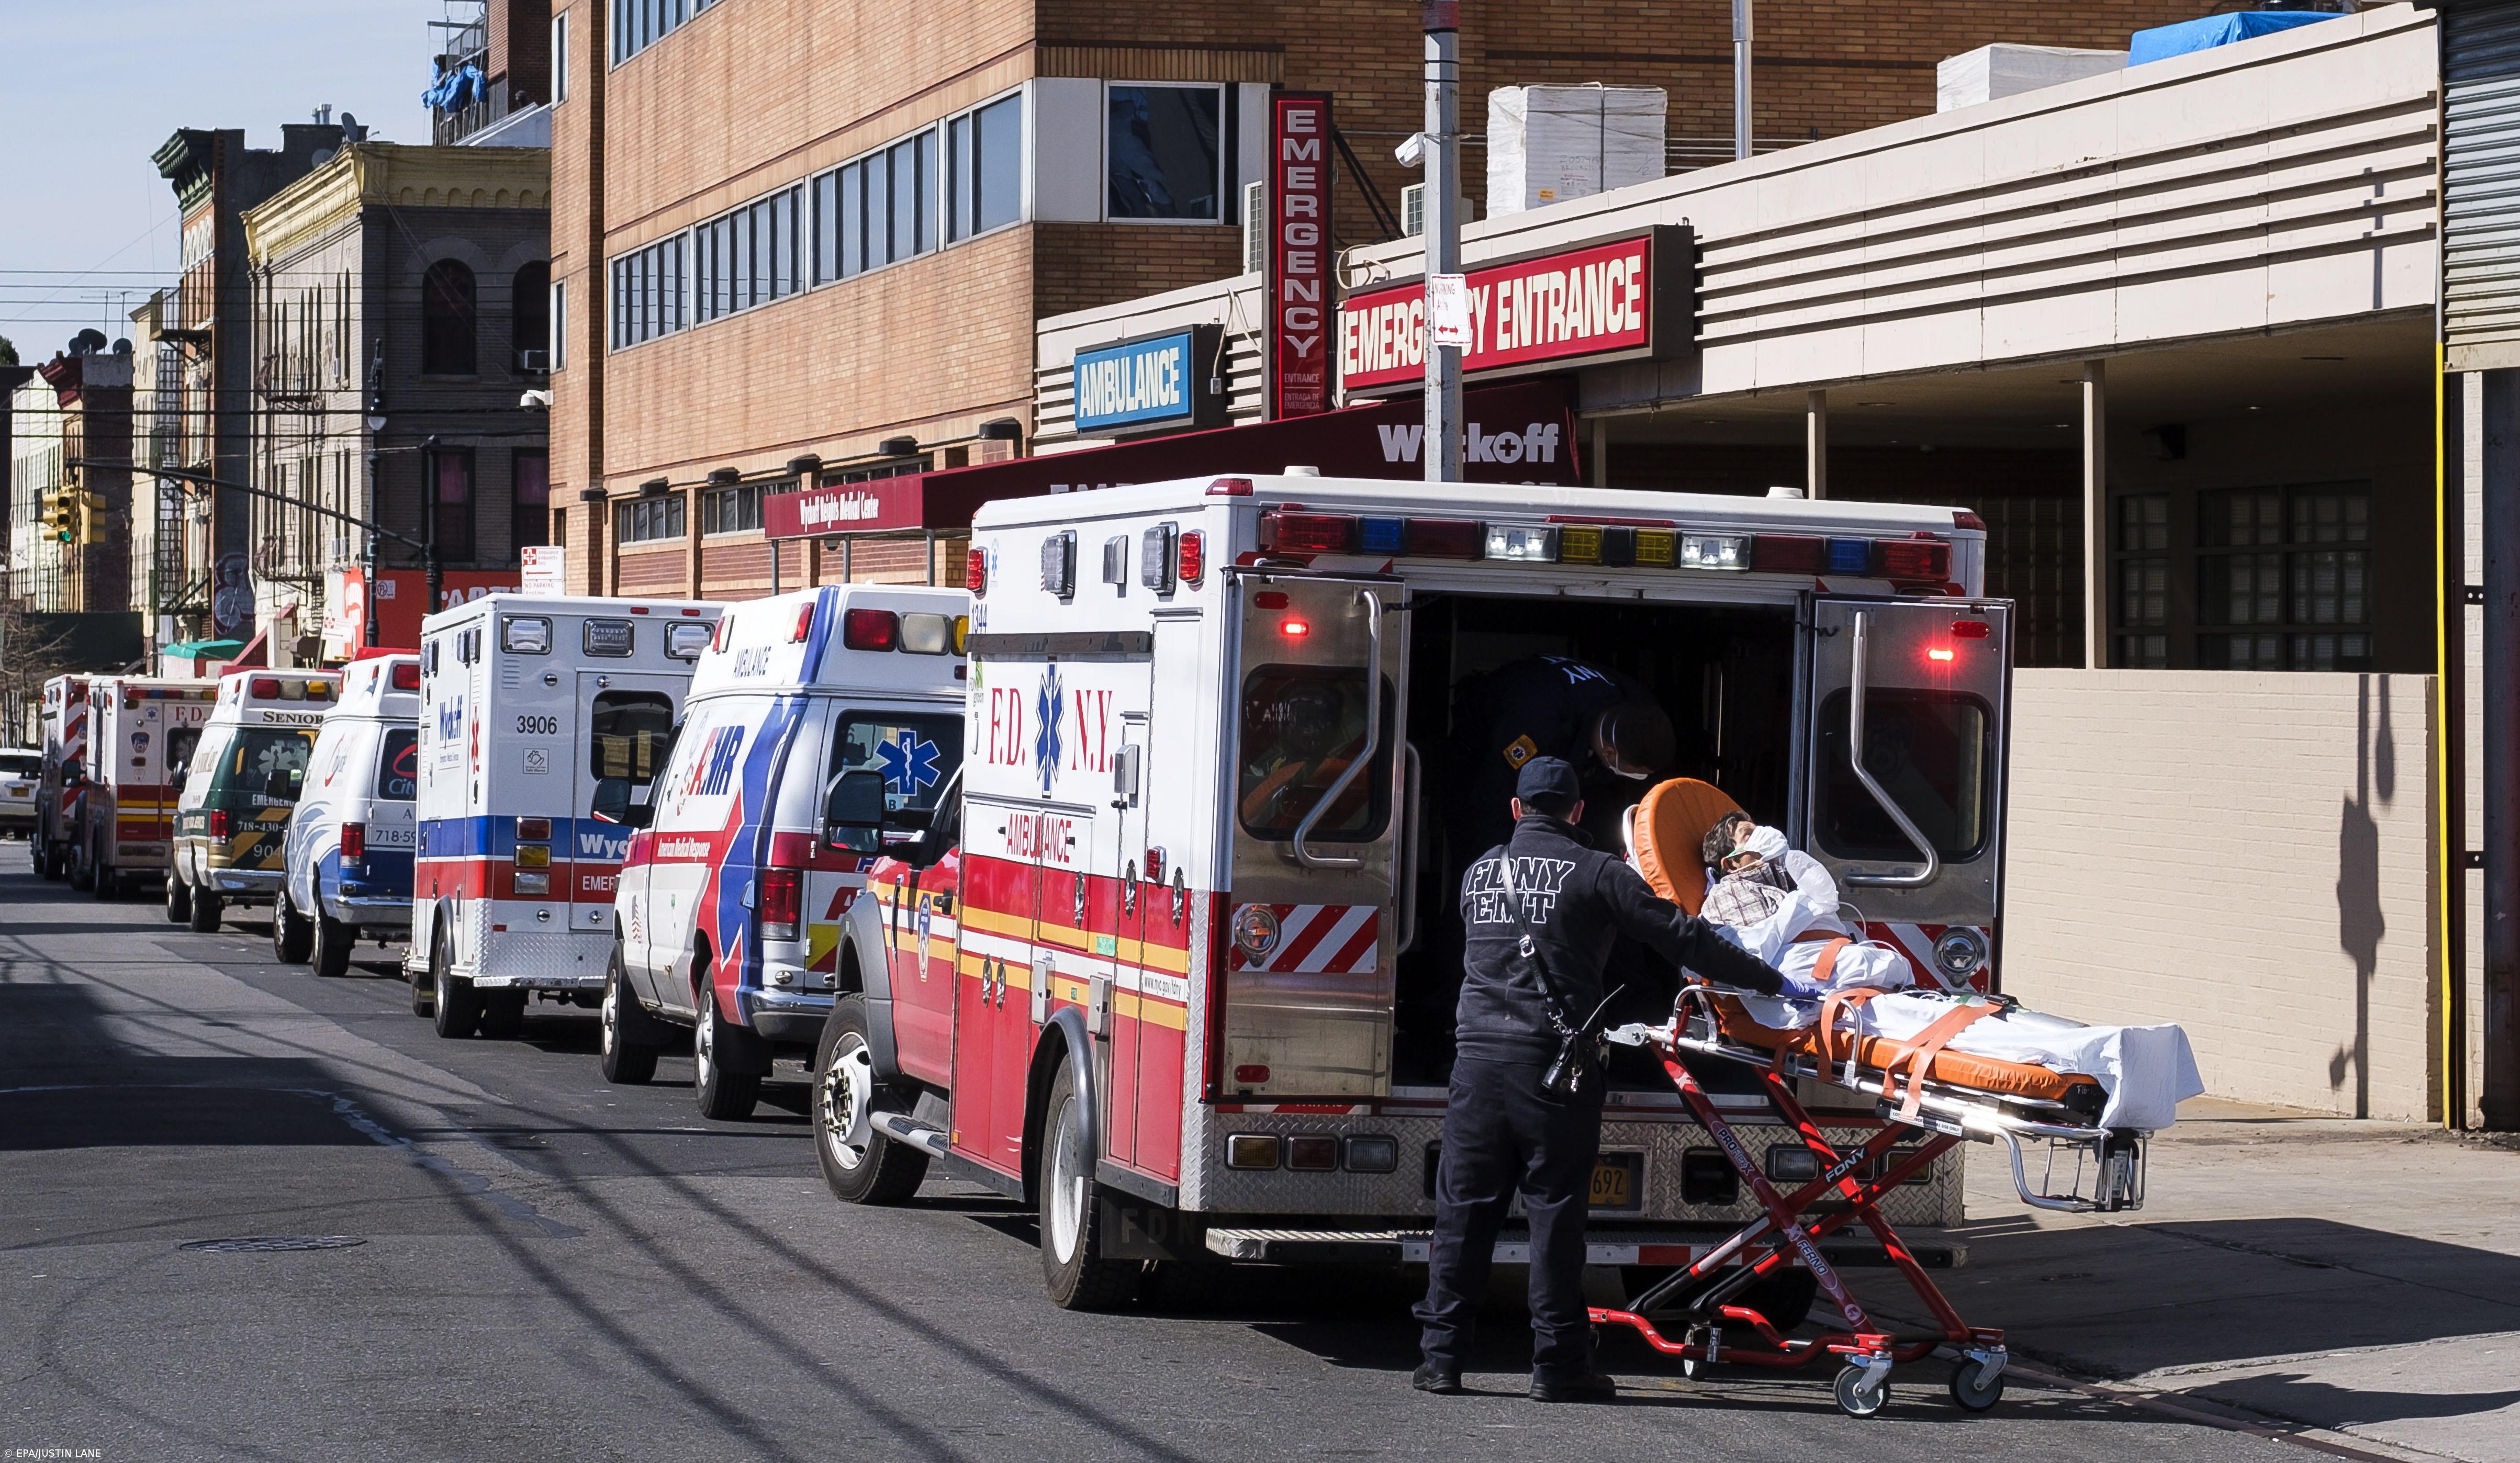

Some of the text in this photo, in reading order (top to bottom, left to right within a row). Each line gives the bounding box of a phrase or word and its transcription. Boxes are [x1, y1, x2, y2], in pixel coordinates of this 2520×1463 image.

[1283, 109, 1320, 358] EMERGENCY
[1344, 254, 1641, 376] EMERGY ENTRANCE
[1079, 346, 1180, 418] AMBULANCE
[1284, 373, 1320, 383] ENTRANCE
[1284, 393, 1311, 401] ENTRADA
[1377, 422, 1559, 464] Wkoff
[800, 490, 879, 533] Wyckoff Heights Medical Center
[972, 603, 988, 635] 1344
[732, 646, 771, 678] AMBULANCE
[440, 694, 463, 750] Wyckoff
[516, 715, 557, 735] 3906
[688, 725, 745, 795] AMR
[388, 778, 415, 800] City
[657, 837, 710, 862] American Medical Response
[1006, 812, 1072, 864] AMBULANCE
[1465, 857, 1576, 896] FDNY
[1473, 890, 1556, 925] EMT
[1144, 975, 1182, 999] www.nyc.gov/fdny
[1592, 1169, 1623, 1195] 692
[1825, 1146, 1865, 1183] FDNY
[1796, 1239, 1829, 1276] FERNO
